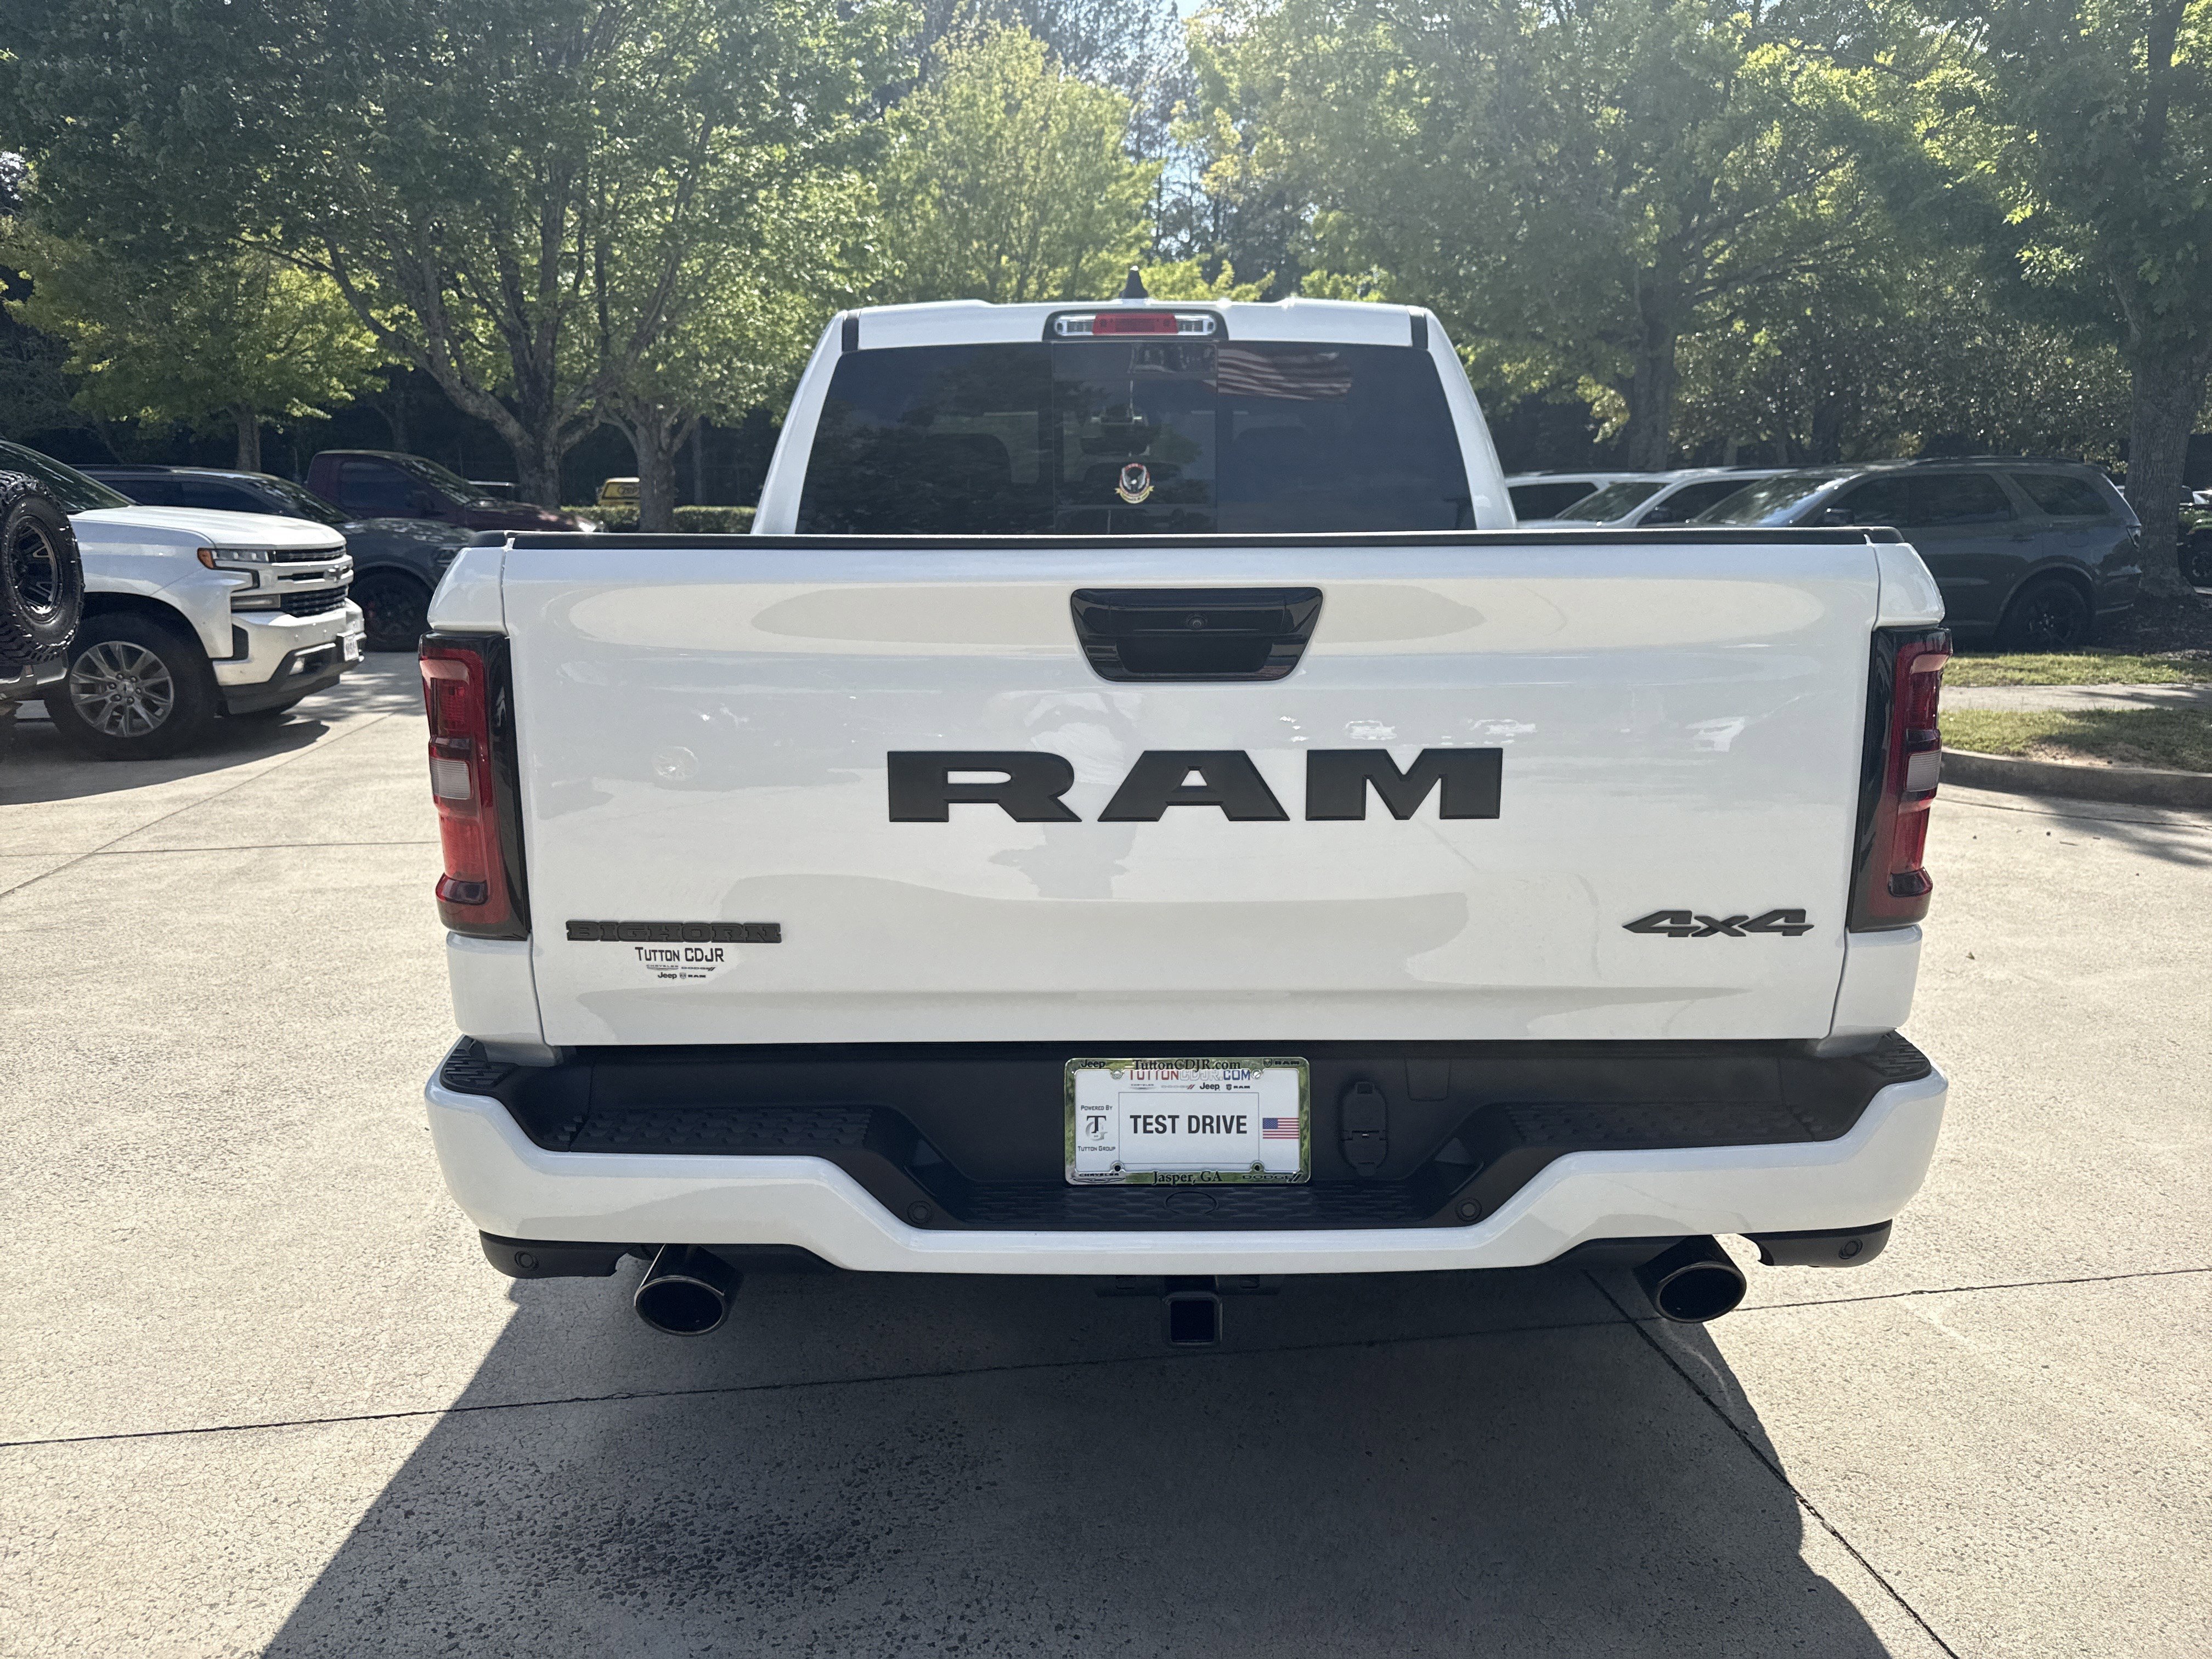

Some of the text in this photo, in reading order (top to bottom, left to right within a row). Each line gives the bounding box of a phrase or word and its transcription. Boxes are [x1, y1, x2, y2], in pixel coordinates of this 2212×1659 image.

[887, 747, 1503, 822] RAM
[685, 948, 724, 962] CDJR
[1081, 1059, 1106, 1069] Jeep
[1133, 1059, 1240, 1072] TuttonCDJR.com
[1200, 1082, 1220, 1091] Jeep
[1130, 1115, 1247, 1134] TEST DRIVE
[1153, 1171, 1222, 1186] Jasper, GA
